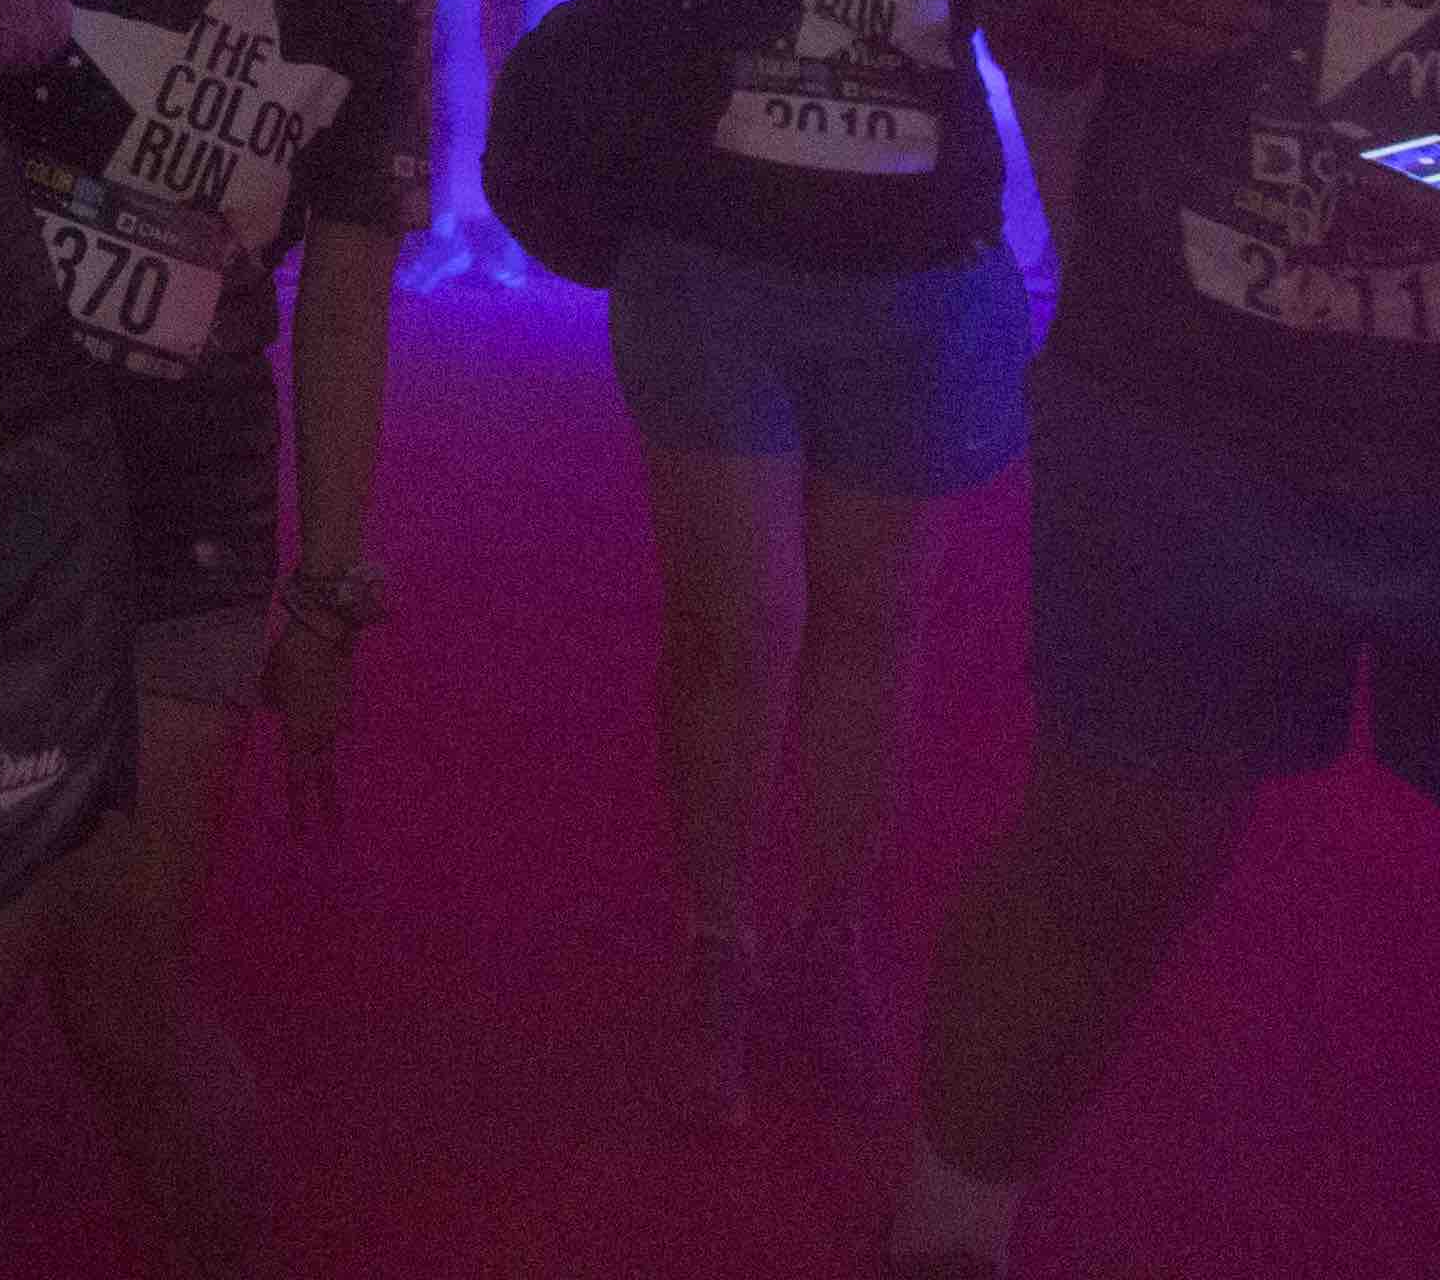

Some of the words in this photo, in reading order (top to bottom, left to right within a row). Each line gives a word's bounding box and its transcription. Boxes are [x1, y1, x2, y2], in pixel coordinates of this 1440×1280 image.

[185, 11, 275, 90] THE
[129, 118, 240, 208] RUN
[155, 63, 304, 168] COLOR
[51, 225, 171, 336] 370
